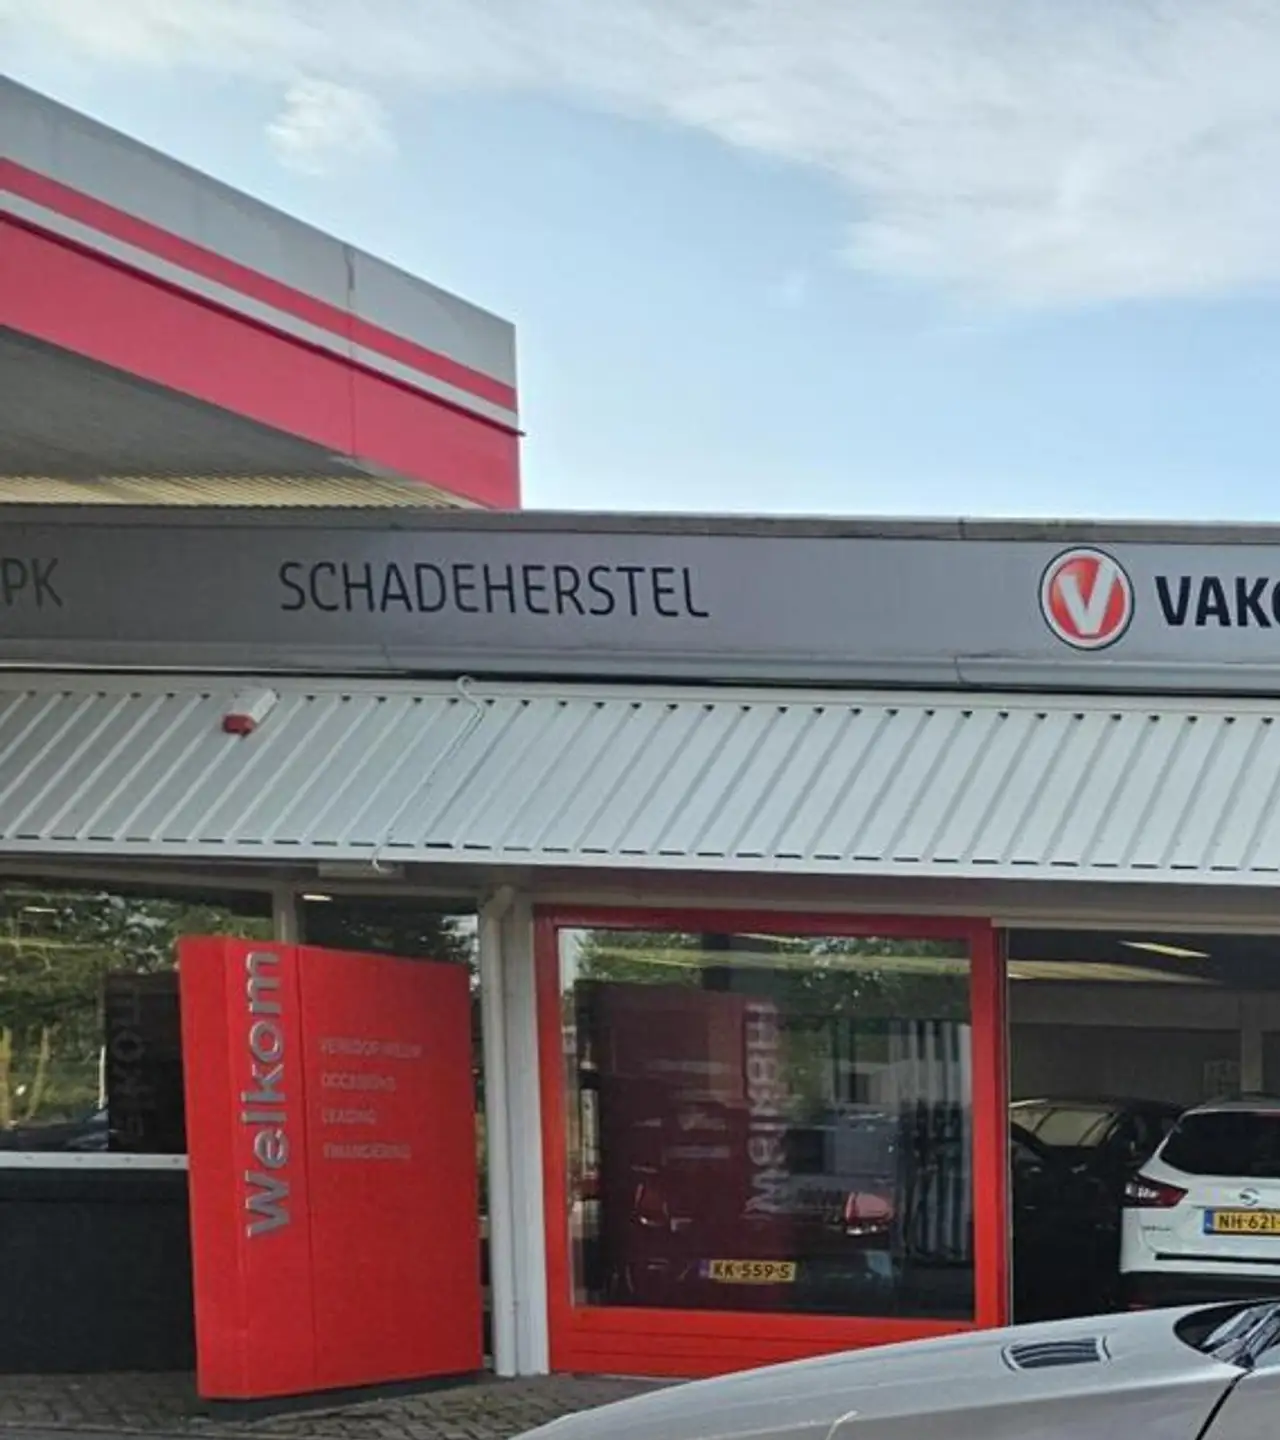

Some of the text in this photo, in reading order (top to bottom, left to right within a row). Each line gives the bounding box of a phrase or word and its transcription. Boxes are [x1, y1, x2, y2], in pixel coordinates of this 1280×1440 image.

[1, 556, 63, 609] PK
[278, 560, 710, 619] SCHADEHERSTEL
[240, 950, 290, 1239] Welkom
